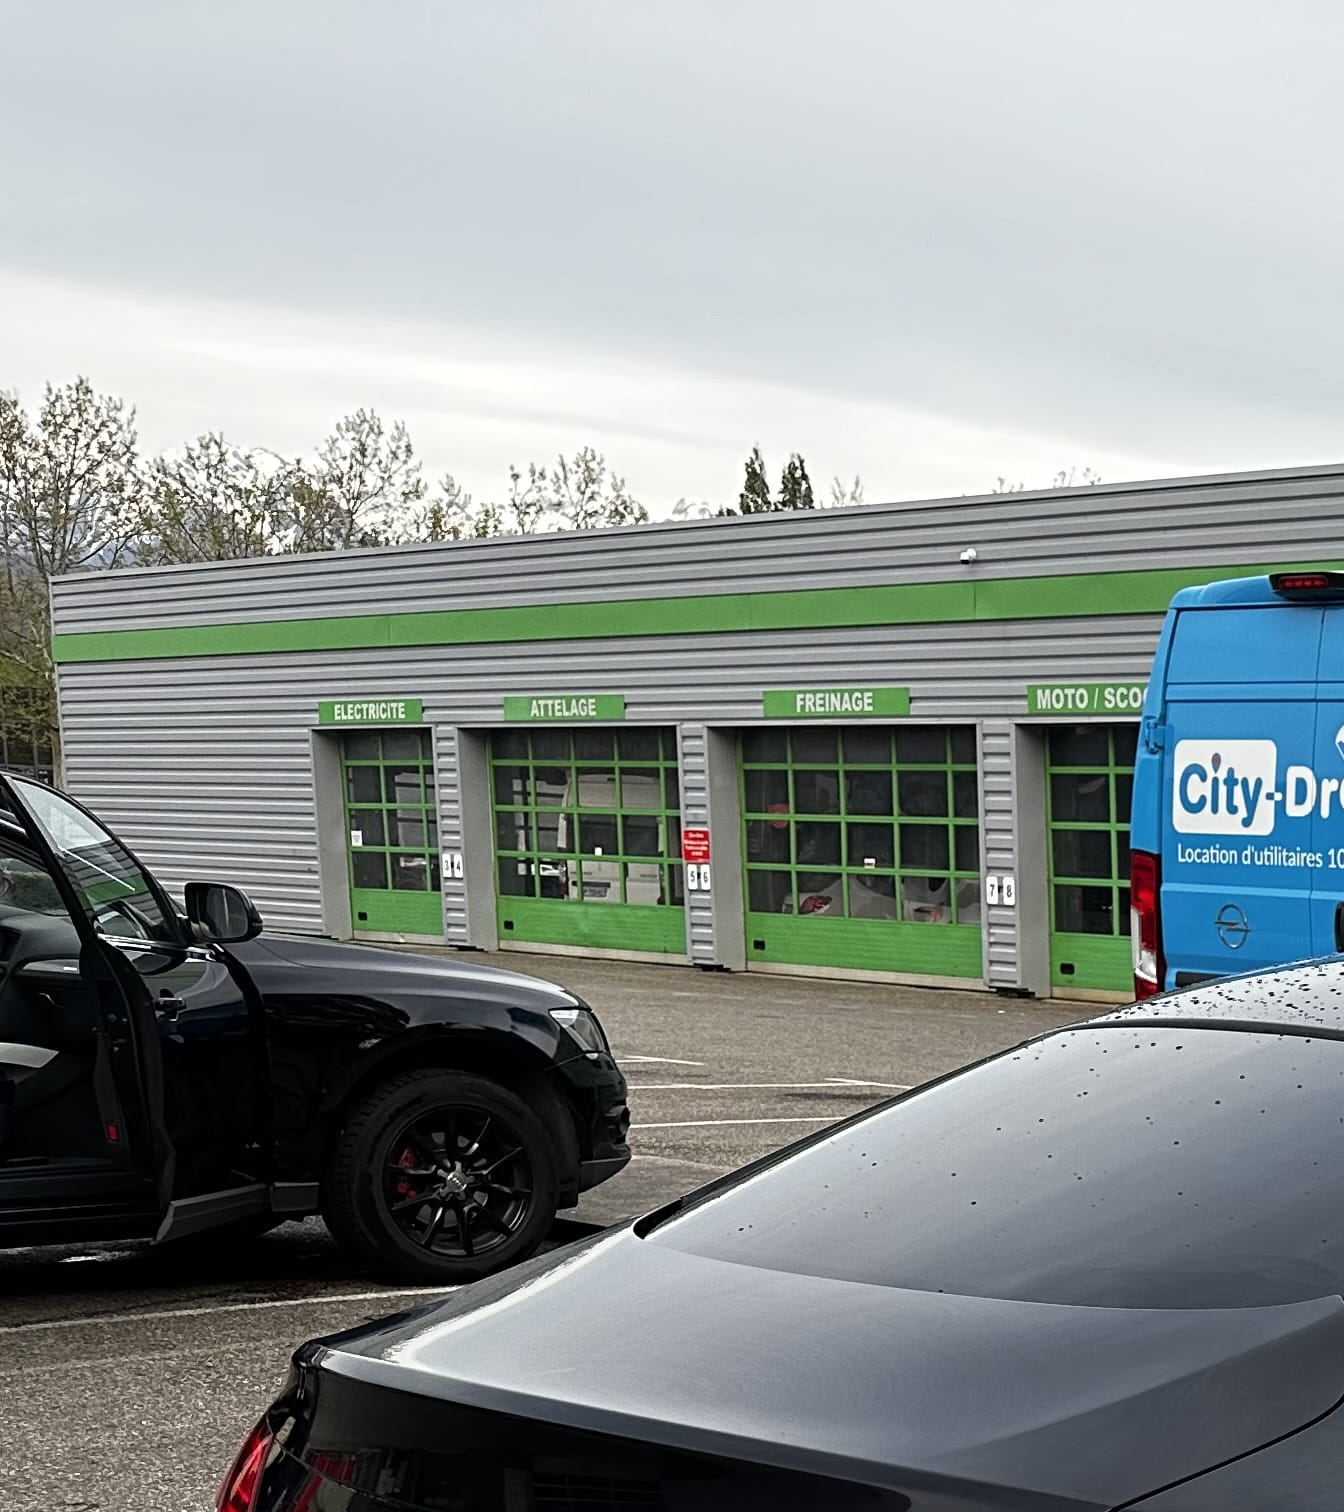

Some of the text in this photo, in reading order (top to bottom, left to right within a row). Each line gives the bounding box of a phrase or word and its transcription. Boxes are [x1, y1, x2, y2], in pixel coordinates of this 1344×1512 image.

[796, 692, 874, 713] FREINAGE
[1037, 688, 1089, 709] MOTO
[1093, 687, 1099, 709] /
[334, 702, 406, 721] ELECTRICITE
[530, 698, 597, 717] ATTELAGE
[1177, 843, 1238, 865] Location
[1242, 846, 1323, 868] d'utilitaires
[443, 859, 450, 871] 3
[690, 870, 696, 882] 5
[703, 871, 709, 883] 6
[990, 883, 996, 897] 7
[1006, 884, 1012, 898] 8
